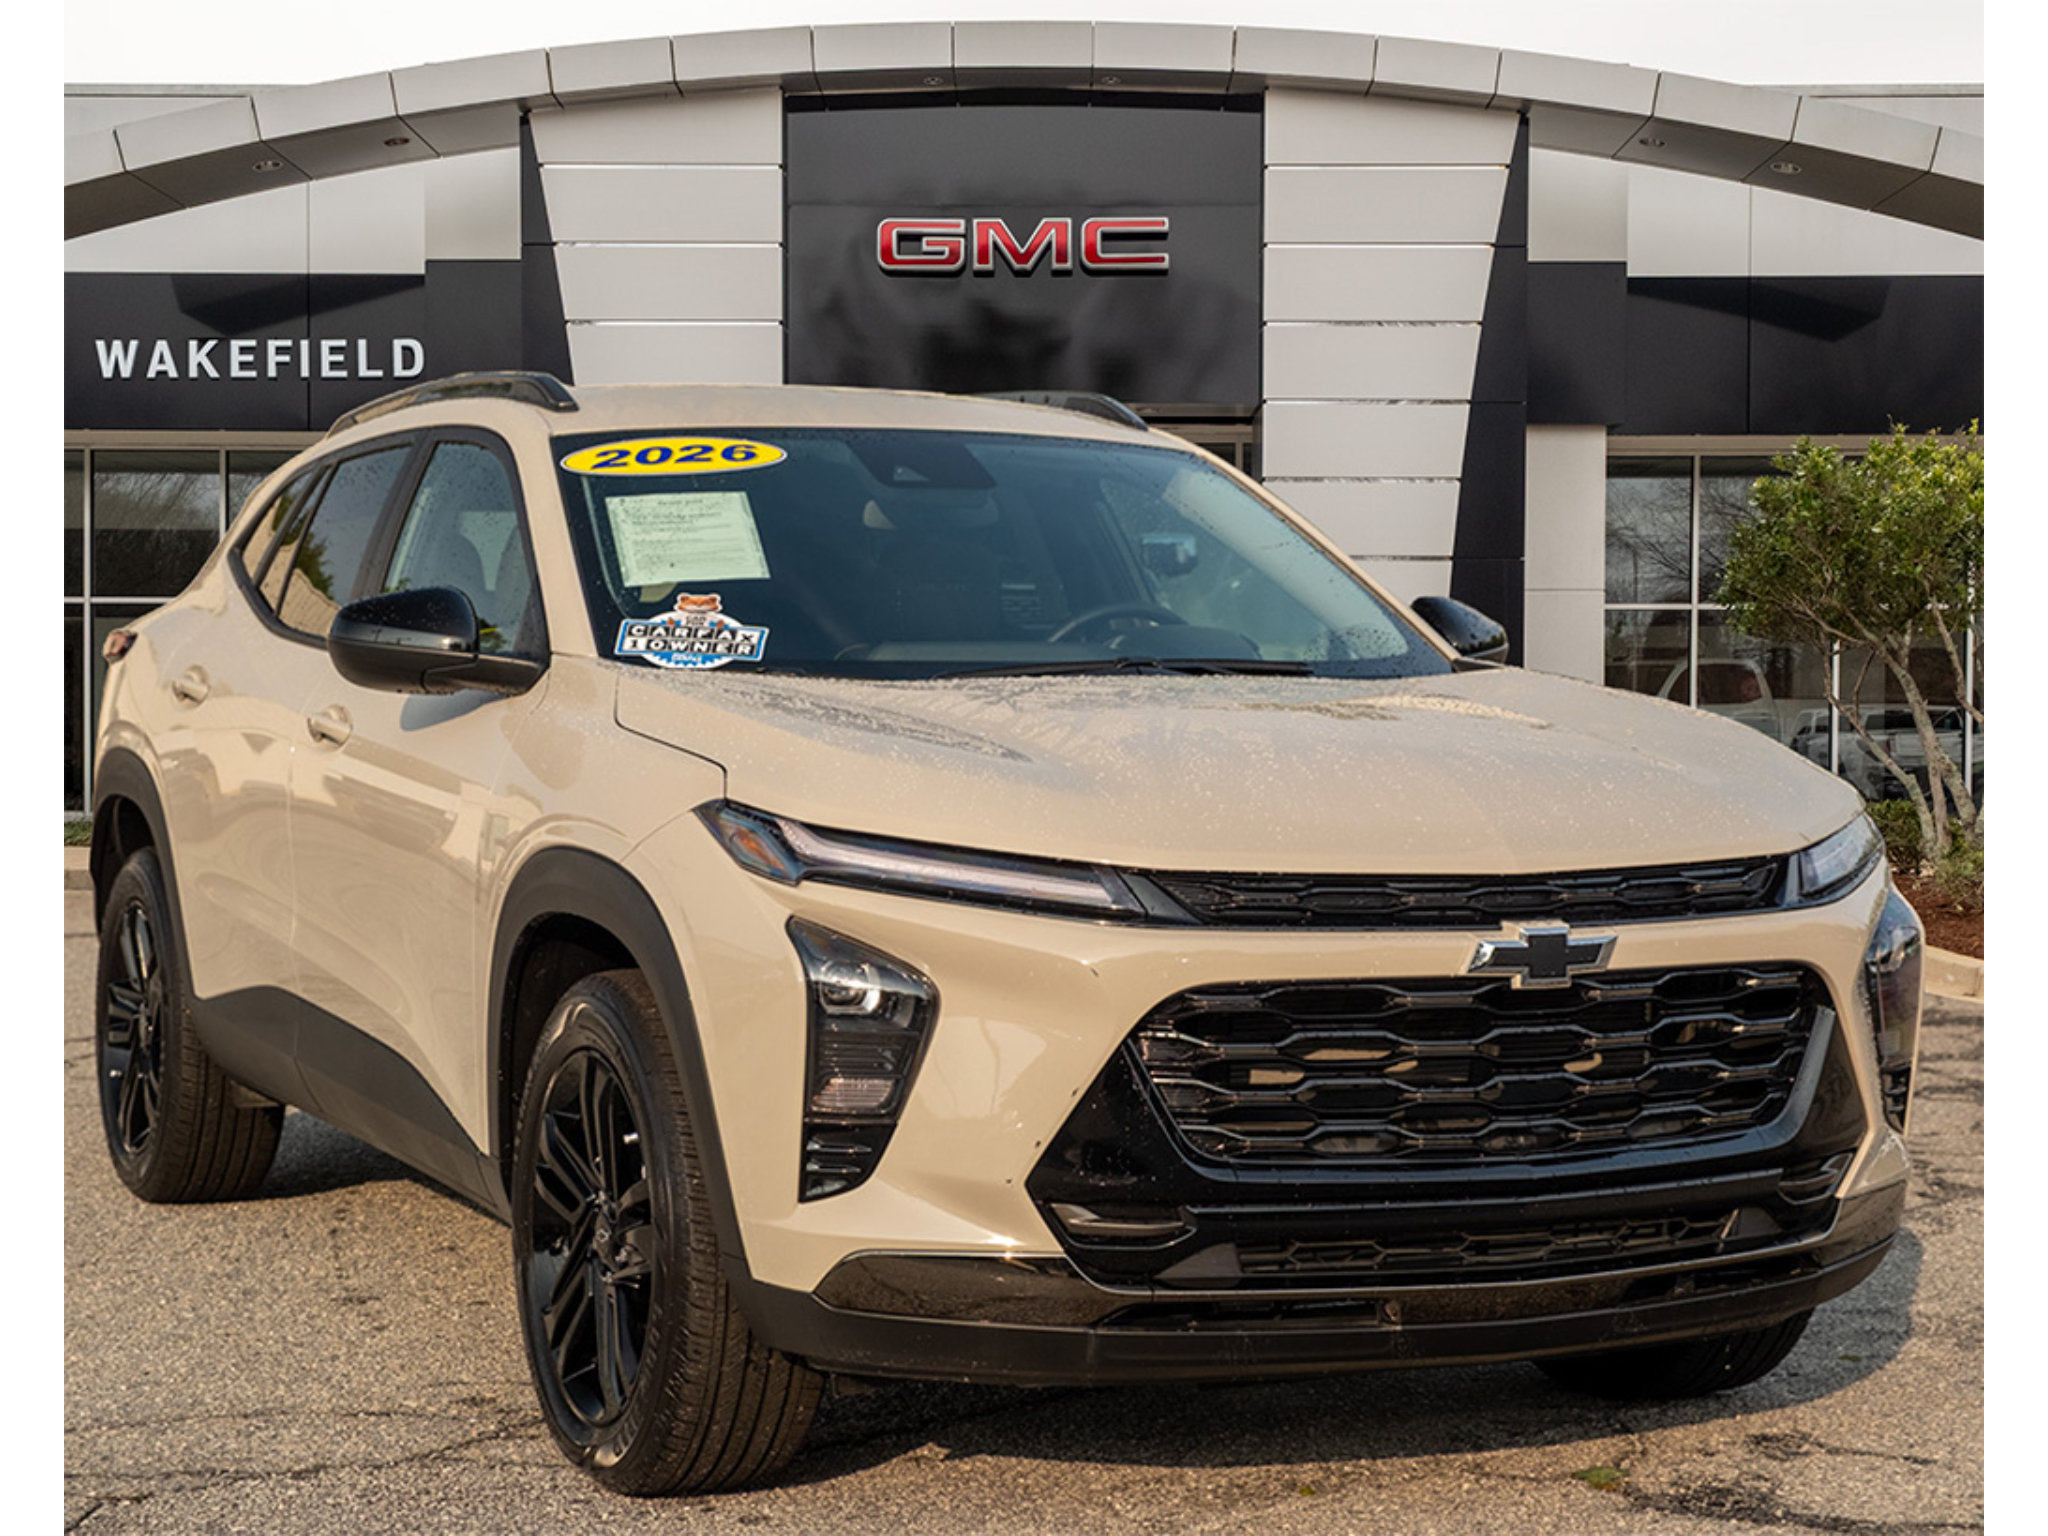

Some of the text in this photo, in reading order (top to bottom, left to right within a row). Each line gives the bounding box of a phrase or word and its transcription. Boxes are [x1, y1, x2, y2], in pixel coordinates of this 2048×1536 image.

[876, 216, 1170, 274] GMC
[95, 338, 426, 380] WAKEFIELD
[590, 444, 759, 470] 2026
[629, 624, 754, 643] CARFAX
[648, 639, 754, 656] OWNER
